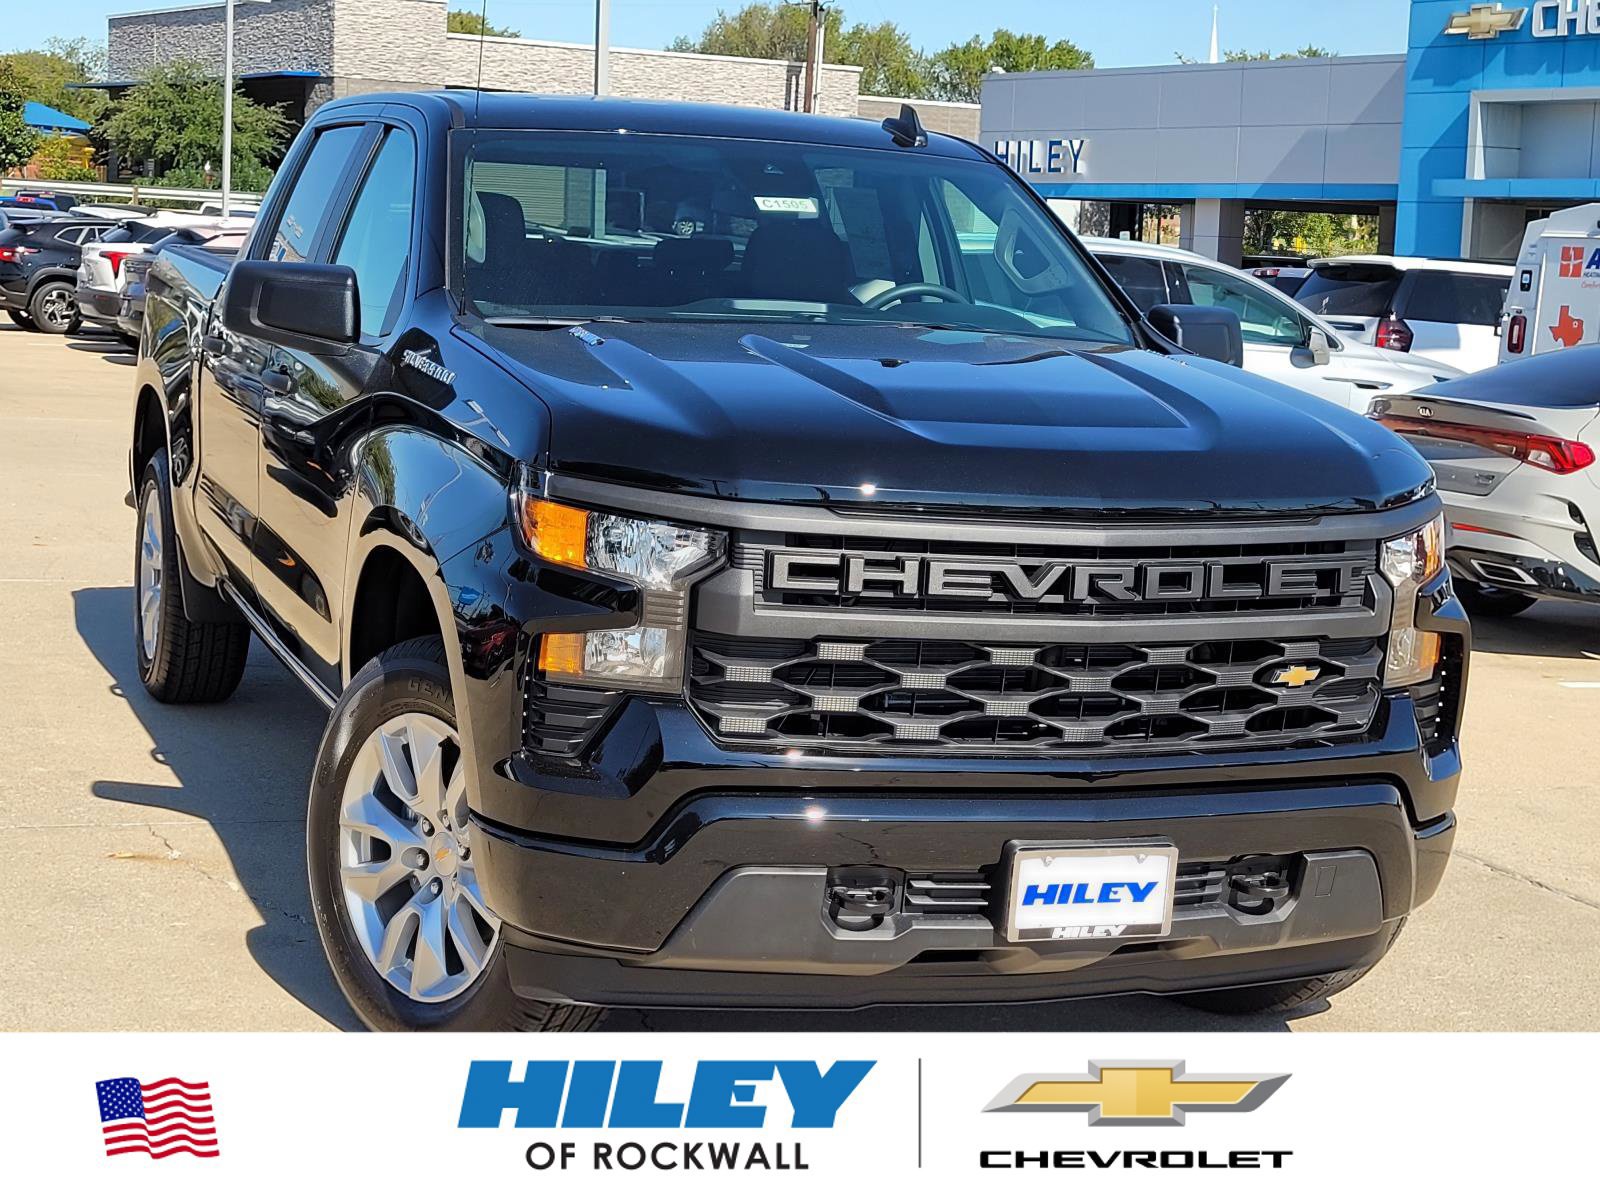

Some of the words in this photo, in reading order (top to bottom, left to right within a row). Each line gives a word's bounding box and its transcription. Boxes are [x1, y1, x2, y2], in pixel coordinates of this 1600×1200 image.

[995, 139, 1085, 174] HILEY
[762, 198, 809, 210] C1505
[769, 551, 1370, 599] CHEVROLET
[1022, 881, 1159, 906] HILEY
[1052, 924, 1128, 940] HILEY
